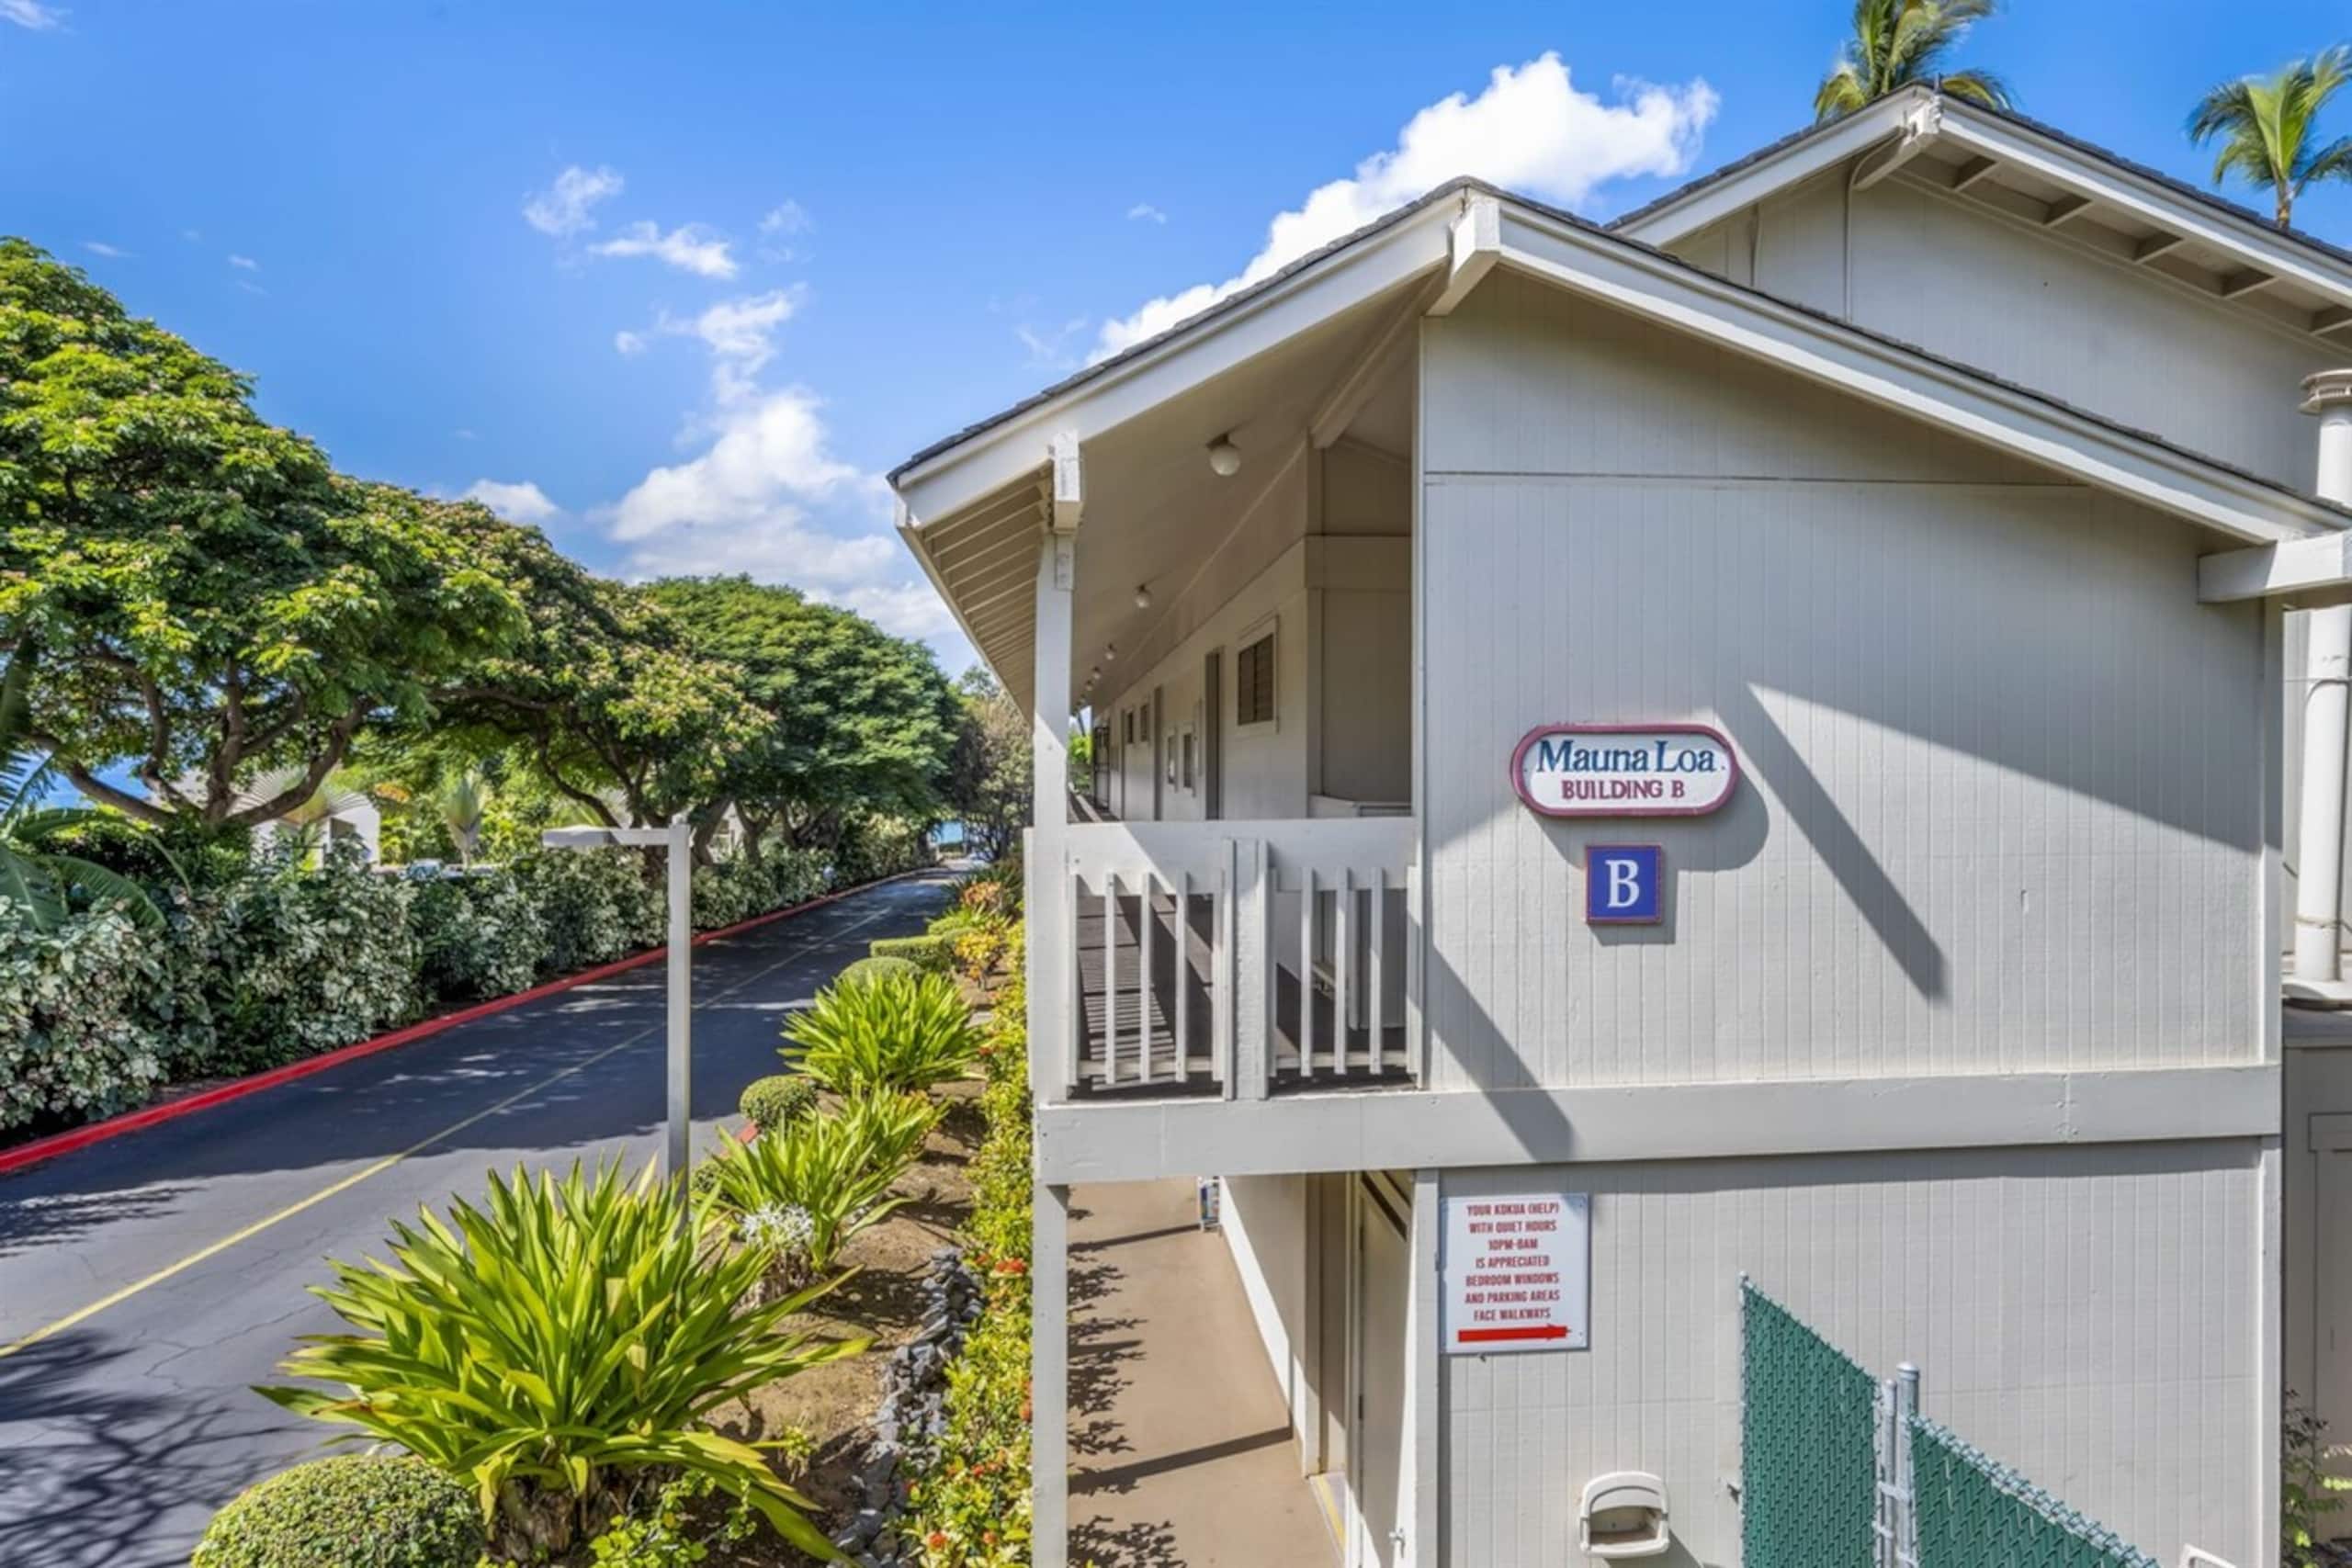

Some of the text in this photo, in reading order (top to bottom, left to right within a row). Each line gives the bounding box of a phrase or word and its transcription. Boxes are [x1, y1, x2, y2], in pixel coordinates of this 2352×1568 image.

[1537, 739, 1715, 773] Mauna Loa
[1562, 780, 1685, 800] BUILDING B
[1605, 860, 1640, 908] B
[1466, 1202, 1559, 1216] YOUR KOKUA (HELP)
[1470, 1220, 1557, 1234] WITH QUIET HOURS
[1476, 1255, 1550, 1269] IS APPRECIATED
[1466, 1272, 1559, 1286] BEDROOM WINDOWS
[1464, 1290, 1560, 1303] AND PARKING AREAS
[1474, 1308, 1551, 1322] FACE WALKWAYS
